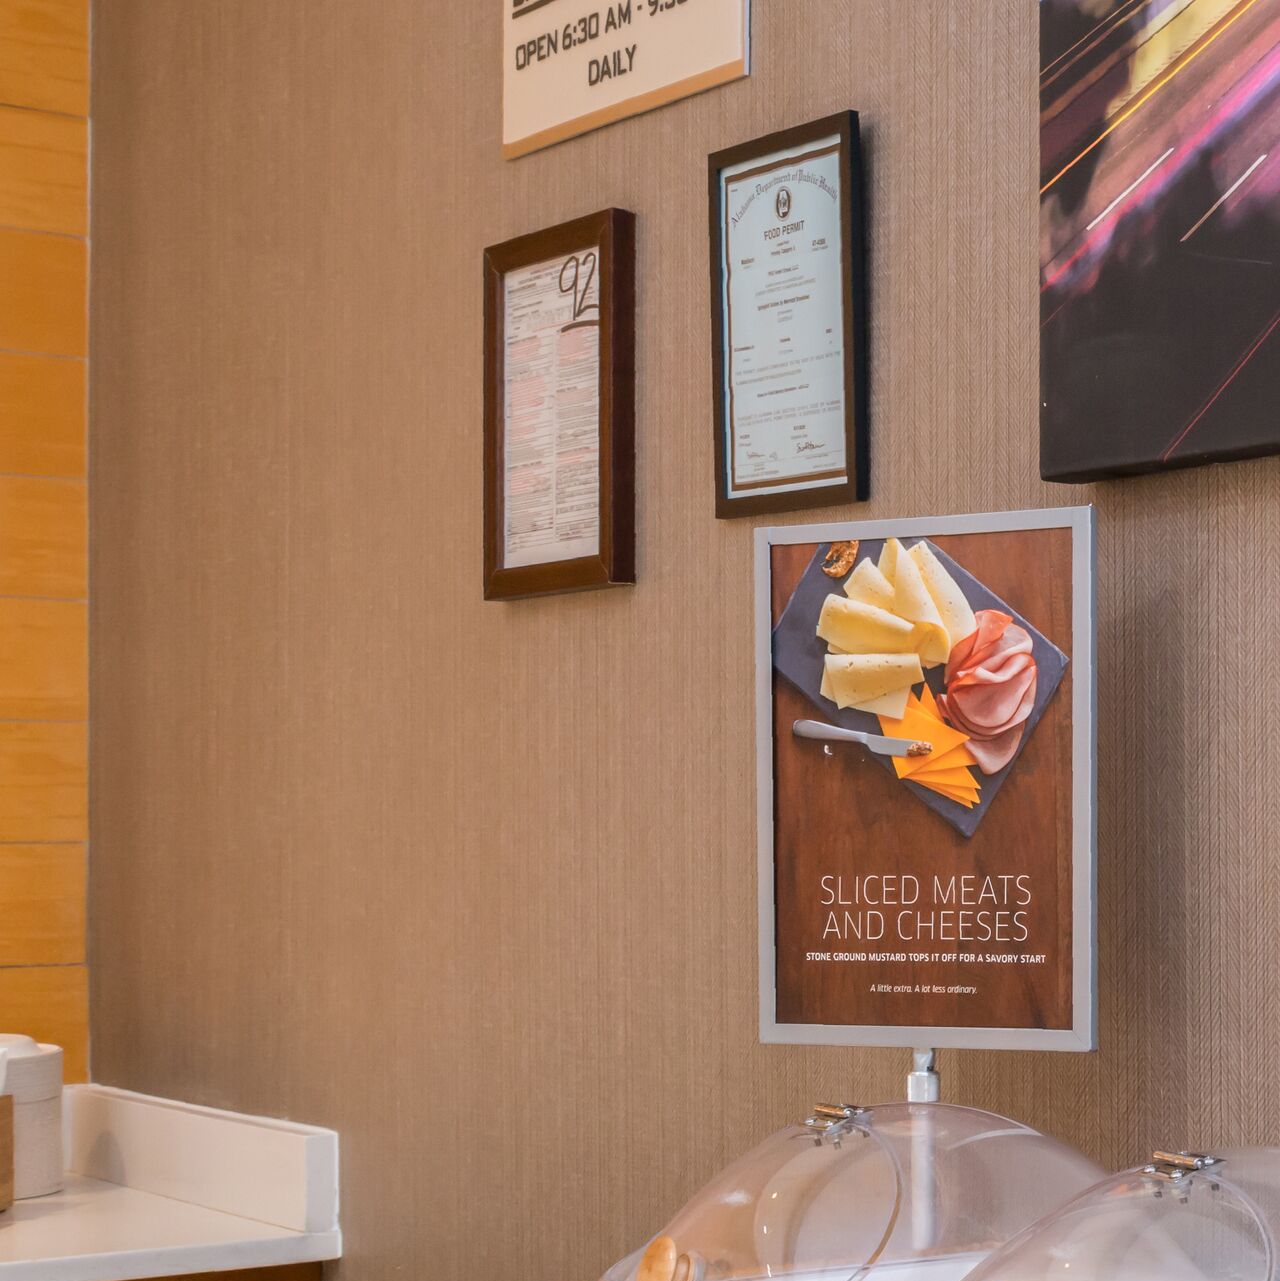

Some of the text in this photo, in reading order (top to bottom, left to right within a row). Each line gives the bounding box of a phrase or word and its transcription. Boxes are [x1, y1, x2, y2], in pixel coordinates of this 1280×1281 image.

[515, 30, 558, 71] OPEN
[562, 12, 600, 50] 6:30
[604, 0, 632, 33] AM
[588, 44, 637, 87] DAILY
[731, 169, 838, 229] Alabama Department of Public Health
[763, 220, 805, 241] FOOD PERMIT
[559, 252, 600, 321] 92
[820, 874, 1032, 905] SLICED MEATS
[822, 910, 1029, 942] AND CHEESES
[806, 952, 1046, 964] STONE GROUND MUSTARD TOPS IT OFF FOR A SAVORY START
[869, 983, 978, 995] A little extra. A lot less ordinary.
